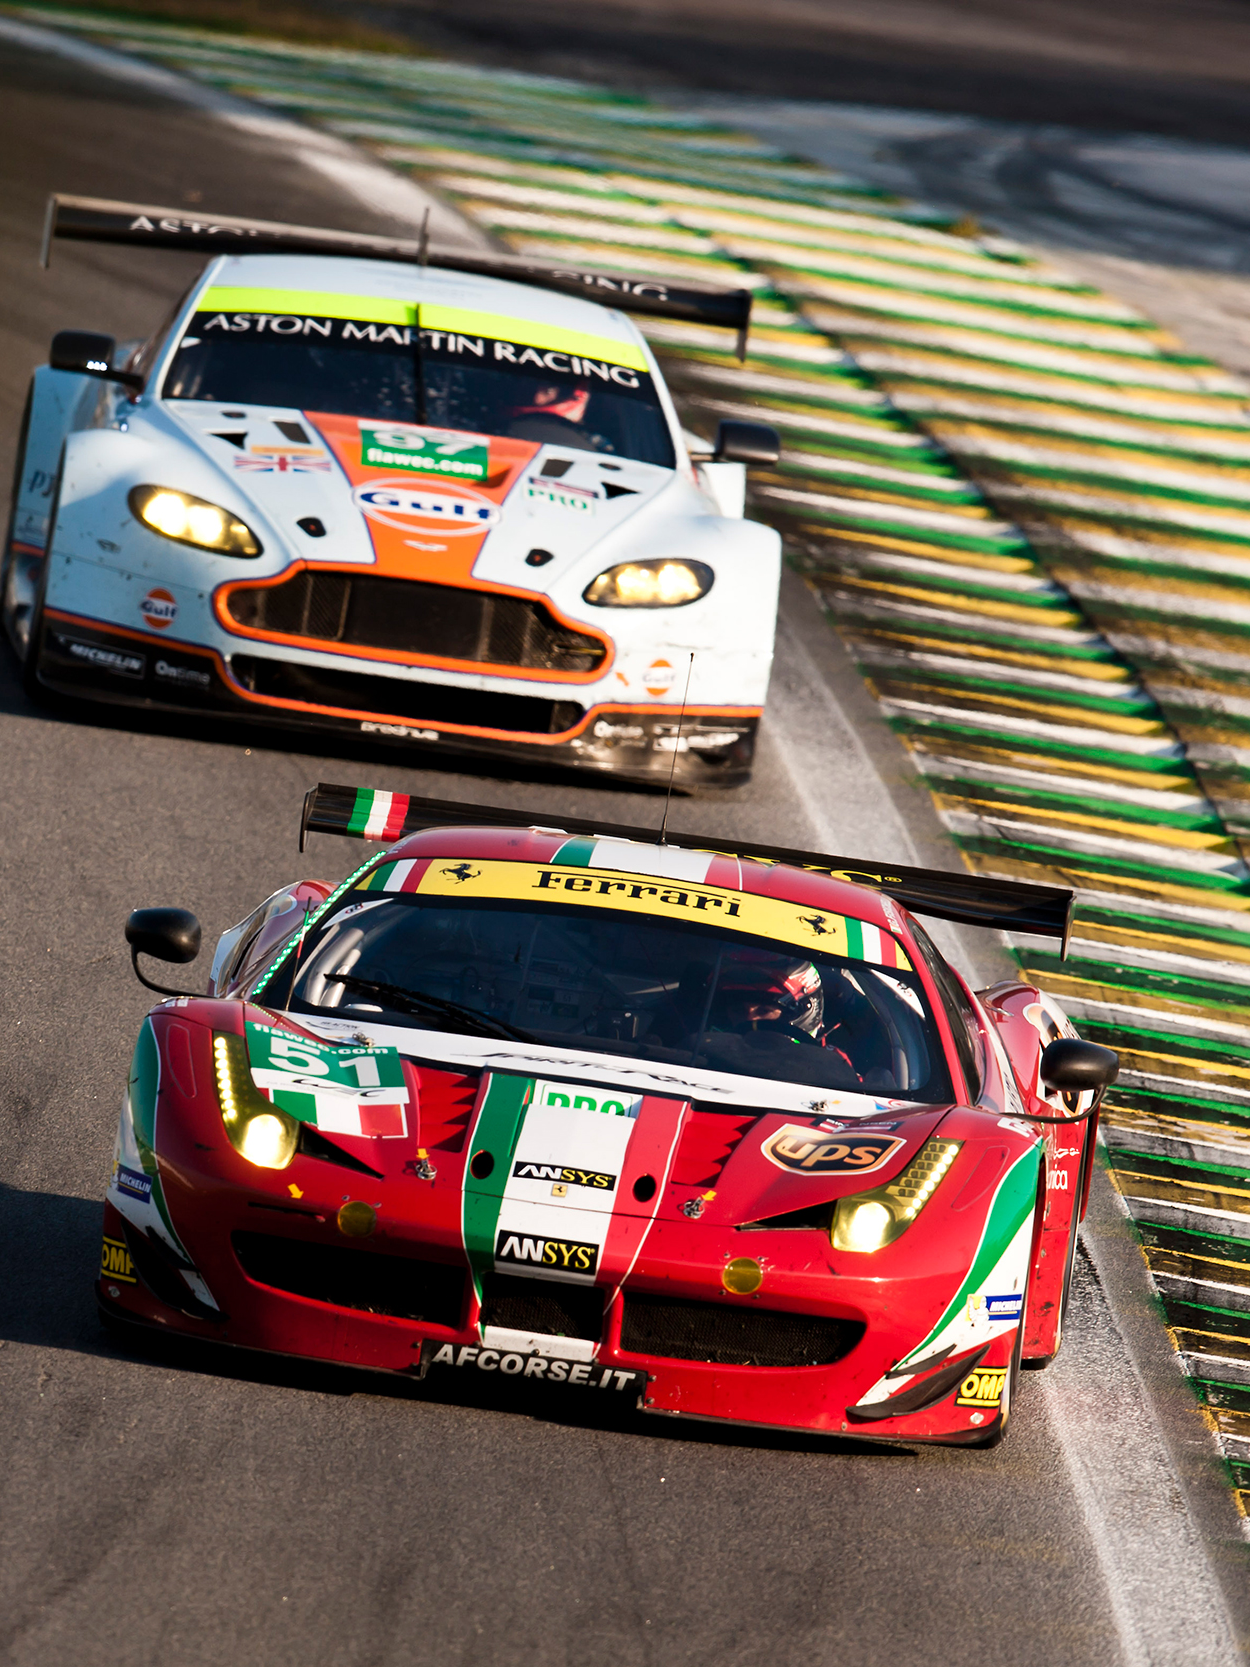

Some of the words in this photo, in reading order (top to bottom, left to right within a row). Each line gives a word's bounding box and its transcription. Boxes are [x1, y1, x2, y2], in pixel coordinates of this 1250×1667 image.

[203, 313, 333, 337] ASTON
[493, 341, 640, 388] RACING
[373, 431, 477, 456] 97
[360, 491, 490, 520] Gulf
[528, 488, 588, 509] PRO
[140, 599, 177, 619] Gulf
[70, 643, 143, 670] MICHELIN
[532, 870, 742, 918] Ferrari
[268, 1036, 381, 1088] 51
[776, 1136, 883, 1167] ups
[120, 1173, 152, 1194] MICHELIN
[517, 1165, 609, 1188] ANSYS
[500, 1236, 591, 1269] ANSYS
[432, 1344, 636, 1391] AFCORSE.IT
